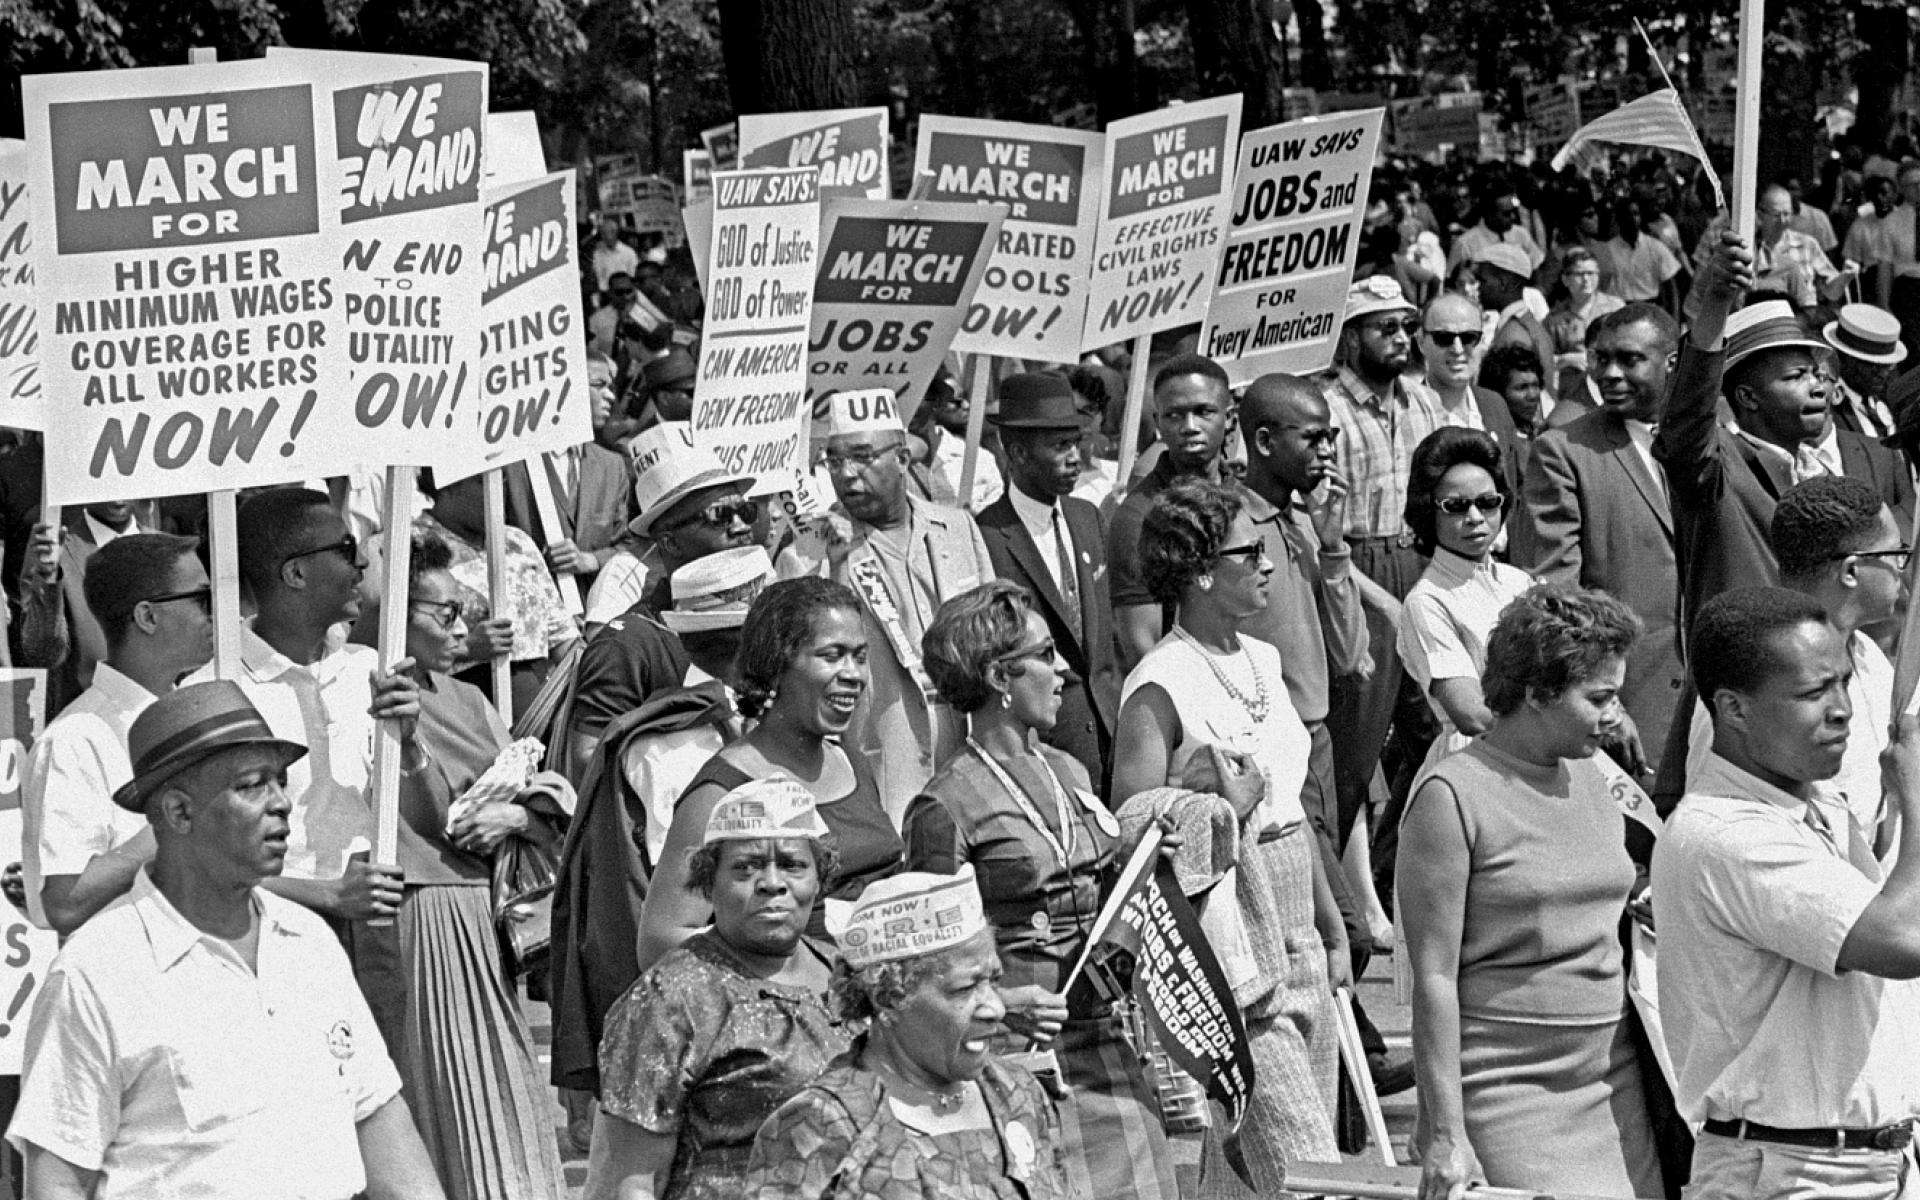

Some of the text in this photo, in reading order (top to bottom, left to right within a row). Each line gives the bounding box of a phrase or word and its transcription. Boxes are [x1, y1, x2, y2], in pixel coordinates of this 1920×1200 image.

[150, 103, 229, 147] WE
[357, 82, 442, 148] WE
[788, 126, 841, 167] WE
[984, 141, 1031, 168] WE
[1152, 127, 1186, 156] WE
[1251, 127, 1364, 168] UAW SAYS
[76, 145, 298, 210] MARCH
[338, 127, 476, 207] EMAND
[819, 149, 878, 186] AND
[936, 164, 1070, 204] MARCH
[1118, 147, 1216, 196] MARCH
[720, 176, 761, 207] UAW
[1147, 185, 1185, 206] FOR
[1232, 170, 1359, 226] JOBS and
[152, 209, 240, 239] FOR
[886, 224, 933, 248] WE
[1114, 205, 1215, 245] EFFECTIVE
[343, 239, 462, 275] N END
[482, 220, 562, 292] MAND
[717, 224, 747, 268] GOD
[751, 222, 772, 267] of
[998, 230, 1076, 260] RATED
[1099, 227, 1218, 272] CIVIL RIGHTS
[1218, 222, 1351, 287] FREEDOM
[114, 248, 282, 291] HIGHER
[374, 277, 412, 290] TO
[828, 251, 964, 283] MARCH
[985, 266, 1070, 297] OOLS
[1127, 258, 1181, 288] LAWS
[55, 291, 220, 334] MINIMUM
[231, 277, 333, 319] WAGES
[345, 293, 441, 328] POLICE
[712, 276, 742, 322] GOD
[746, 278, 767, 319] of
[861, 285, 912, 301] FOR
[1100, 271, 1204, 332] NOW!
[1256, 288, 1296, 309] FOR
[808, 319, 935, 353] JOBS
[961, 302, 1062, 341] OW!
[1207, 311, 1334, 360] Every American
[71, 328, 251, 371] COVERAGE
[267, 320, 326, 352] FOR
[350, 332, 454, 365] UTALITY
[704, 343, 802, 381] CAN AMERICA
[84, 373, 145, 407] ALL
[158, 354, 318, 399] WORKERS
[486, 346, 567, 395] GHTS
[811, 361, 909, 375] OR ALL
[355, 361, 467, 429] OW!
[484, 377, 571, 444] OW!
[696, 396, 736, 431] DENY
[732, 390, 801, 426] FREEDOM
[847, 395, 898, 421] UA
[89, 389, 318, 478] NOW!
[747, 432, 797, 473] HOUR?
[1177, 944, 1236, 1043] WASHINGTON
[1174, 980, 1234, 1062] FREEDOM
